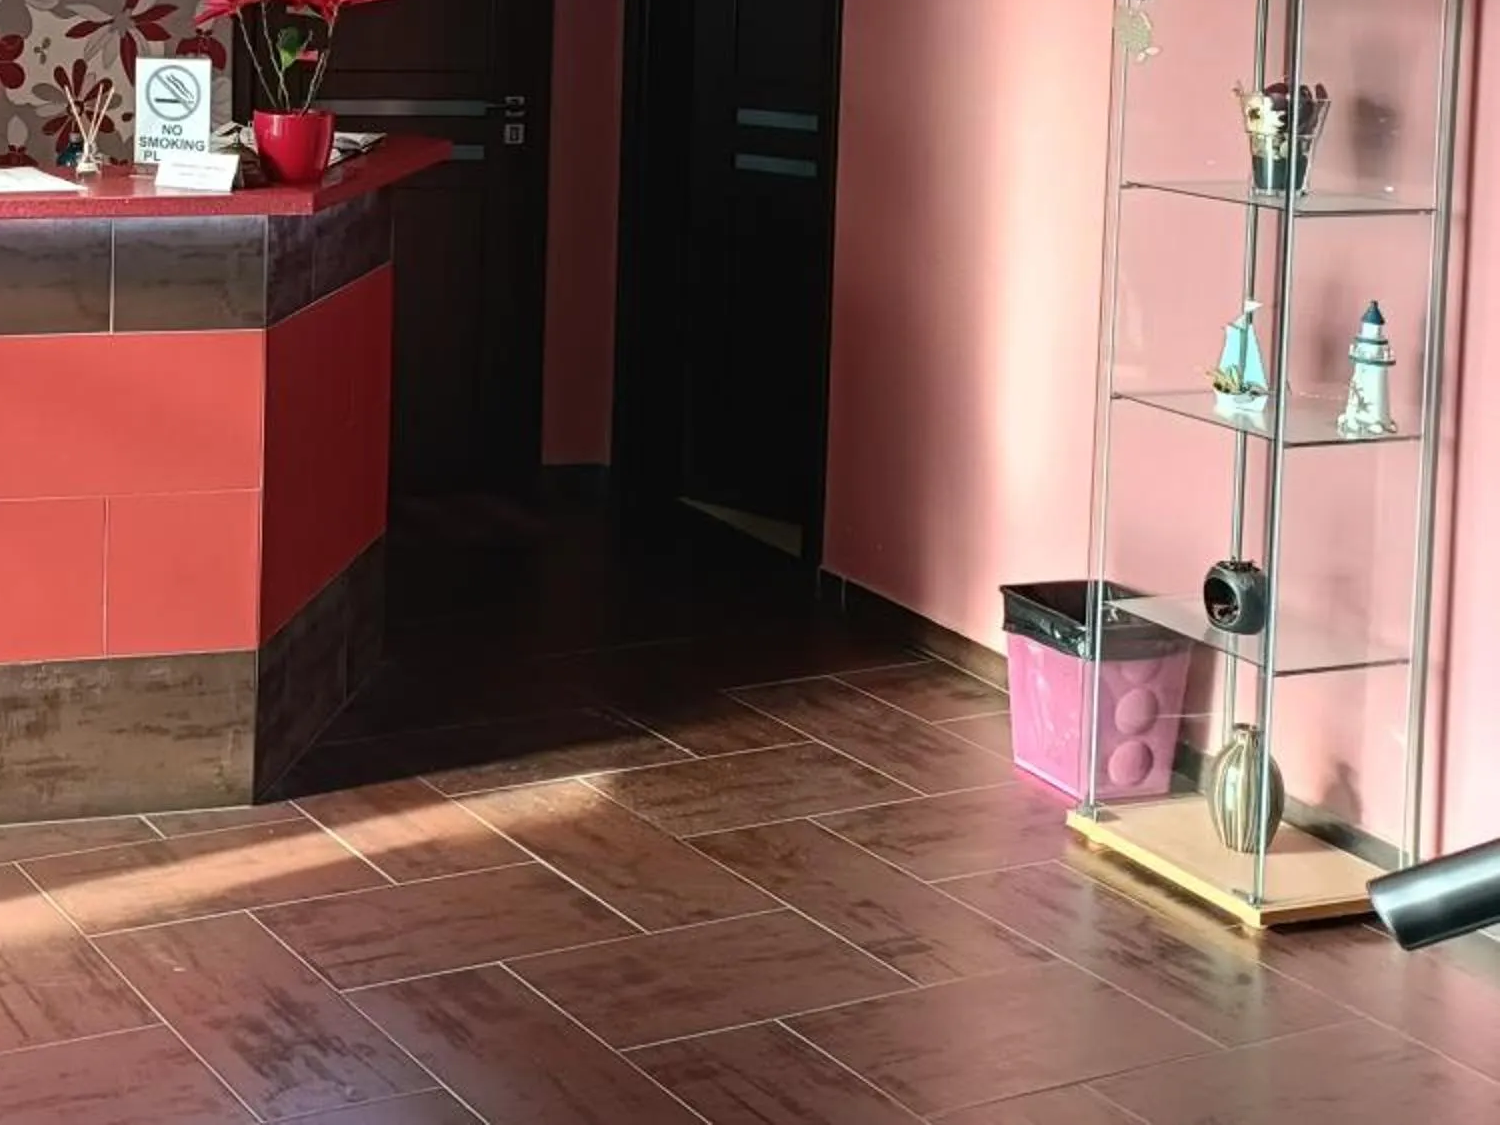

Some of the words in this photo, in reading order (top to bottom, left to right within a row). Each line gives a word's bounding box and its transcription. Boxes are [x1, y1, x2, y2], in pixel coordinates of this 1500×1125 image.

[161, 124, 183, 136] NO
[138, 136, 206, 152] SMOKING
[143, 149, 161, 162] PL
